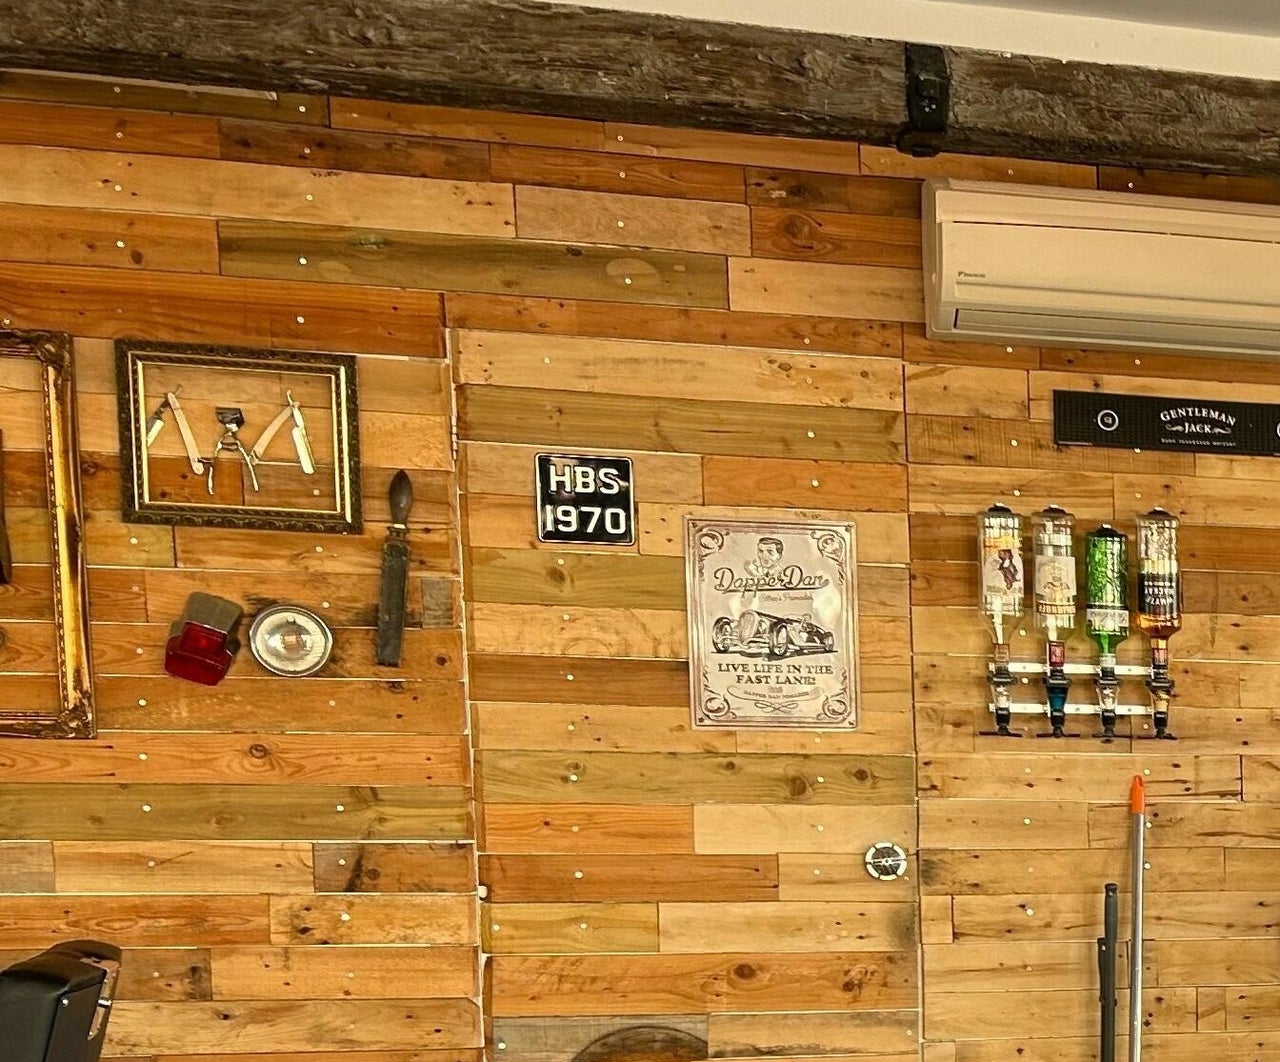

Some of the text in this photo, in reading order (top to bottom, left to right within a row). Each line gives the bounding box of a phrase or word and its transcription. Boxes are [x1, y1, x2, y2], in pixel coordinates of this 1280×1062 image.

[1160, 407, 1236, 426] GENTLEMAN
[1184, 422, 1212, 433] JACK
[549, 465, 620, 494] HBS
[545, 504, 626, 534] 1970
[714, 565, 829, 598] Dapper Dan
[718, 663, 834, 675] LIVE LIFE IN THE
[735, 675, 771, 684] FAST
